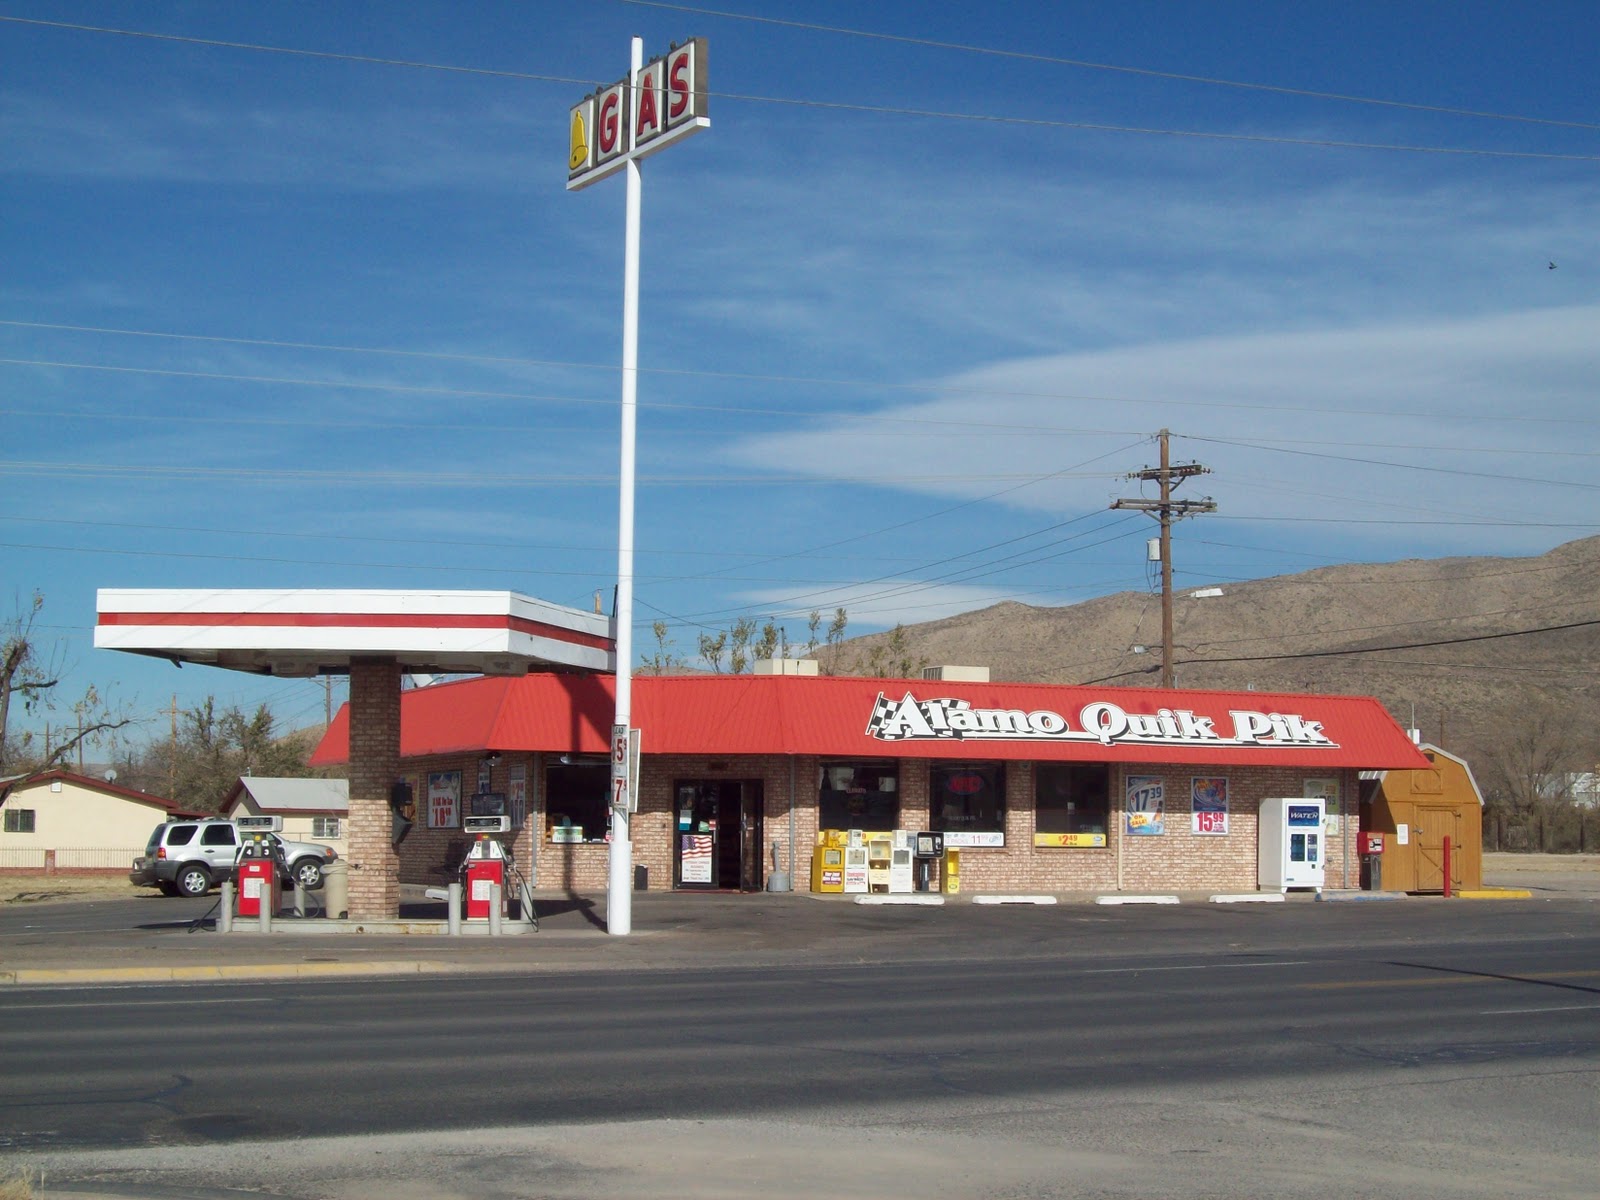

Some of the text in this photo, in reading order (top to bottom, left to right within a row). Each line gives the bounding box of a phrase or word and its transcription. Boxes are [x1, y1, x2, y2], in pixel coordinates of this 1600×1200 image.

[600, 53, 688, 153] GAS
[886, 692, 1330, 744] Alamo Quik Pik
